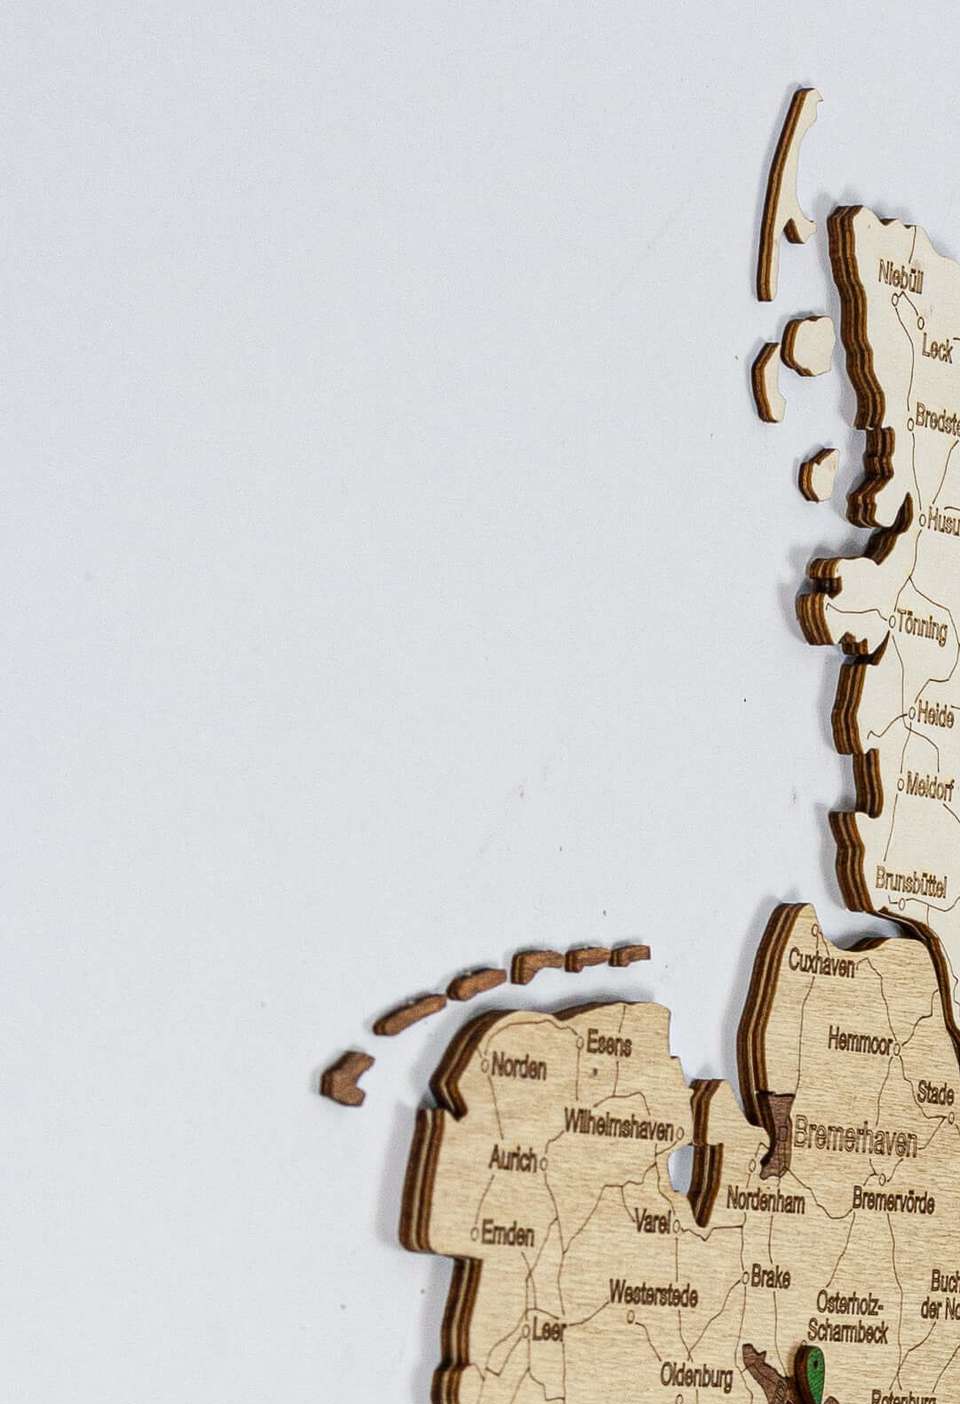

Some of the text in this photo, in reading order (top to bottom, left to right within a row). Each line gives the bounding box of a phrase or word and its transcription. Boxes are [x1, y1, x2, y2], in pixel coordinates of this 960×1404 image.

[879, 259, 924, 294] Niebüll
[923, 332, 953, 363] Leck
[897, 609, 948, 646] Tönning
[917, 702, 954, 728] Heide
[906, 771, 954, 801] Meldorf
[875, 867, 947, 899] Brunsbüttel
[789, 949, 855, 979] Cuxhaven
[586, 1029, 632, 1056] Esens
[828, 1027, 894, 1056] Hemmoor
[491, 1053, 546, 1081] Norden
[917, 1080, 954, 1106] Stade
[565, 1108, 674, 1141] Wilhelmshaven
[794, 1116, 918, 1159] Bremerhaven
[489, 1146, 537, 1172] Aurich
[727, 1186, 805, 1214] Nordenham
[853, 1185, 934, 1215] Bremervörde
[482, 1219, 534, 1247] Emden
[634, 1209, 671, 1234] Varel
[752, 1264, 791, 1289] Brake
[609, 1279, 698, 1309] Westerstede
[816, 1290, 884, 1316] Osterholz-
[921, 1300, 942, 1320] der
[532, 1316, 565, 1341] Leer
[809, 1320, 888, 1345] Scharmbeck
[661, 1362, 733, 1393] Oldenburg
